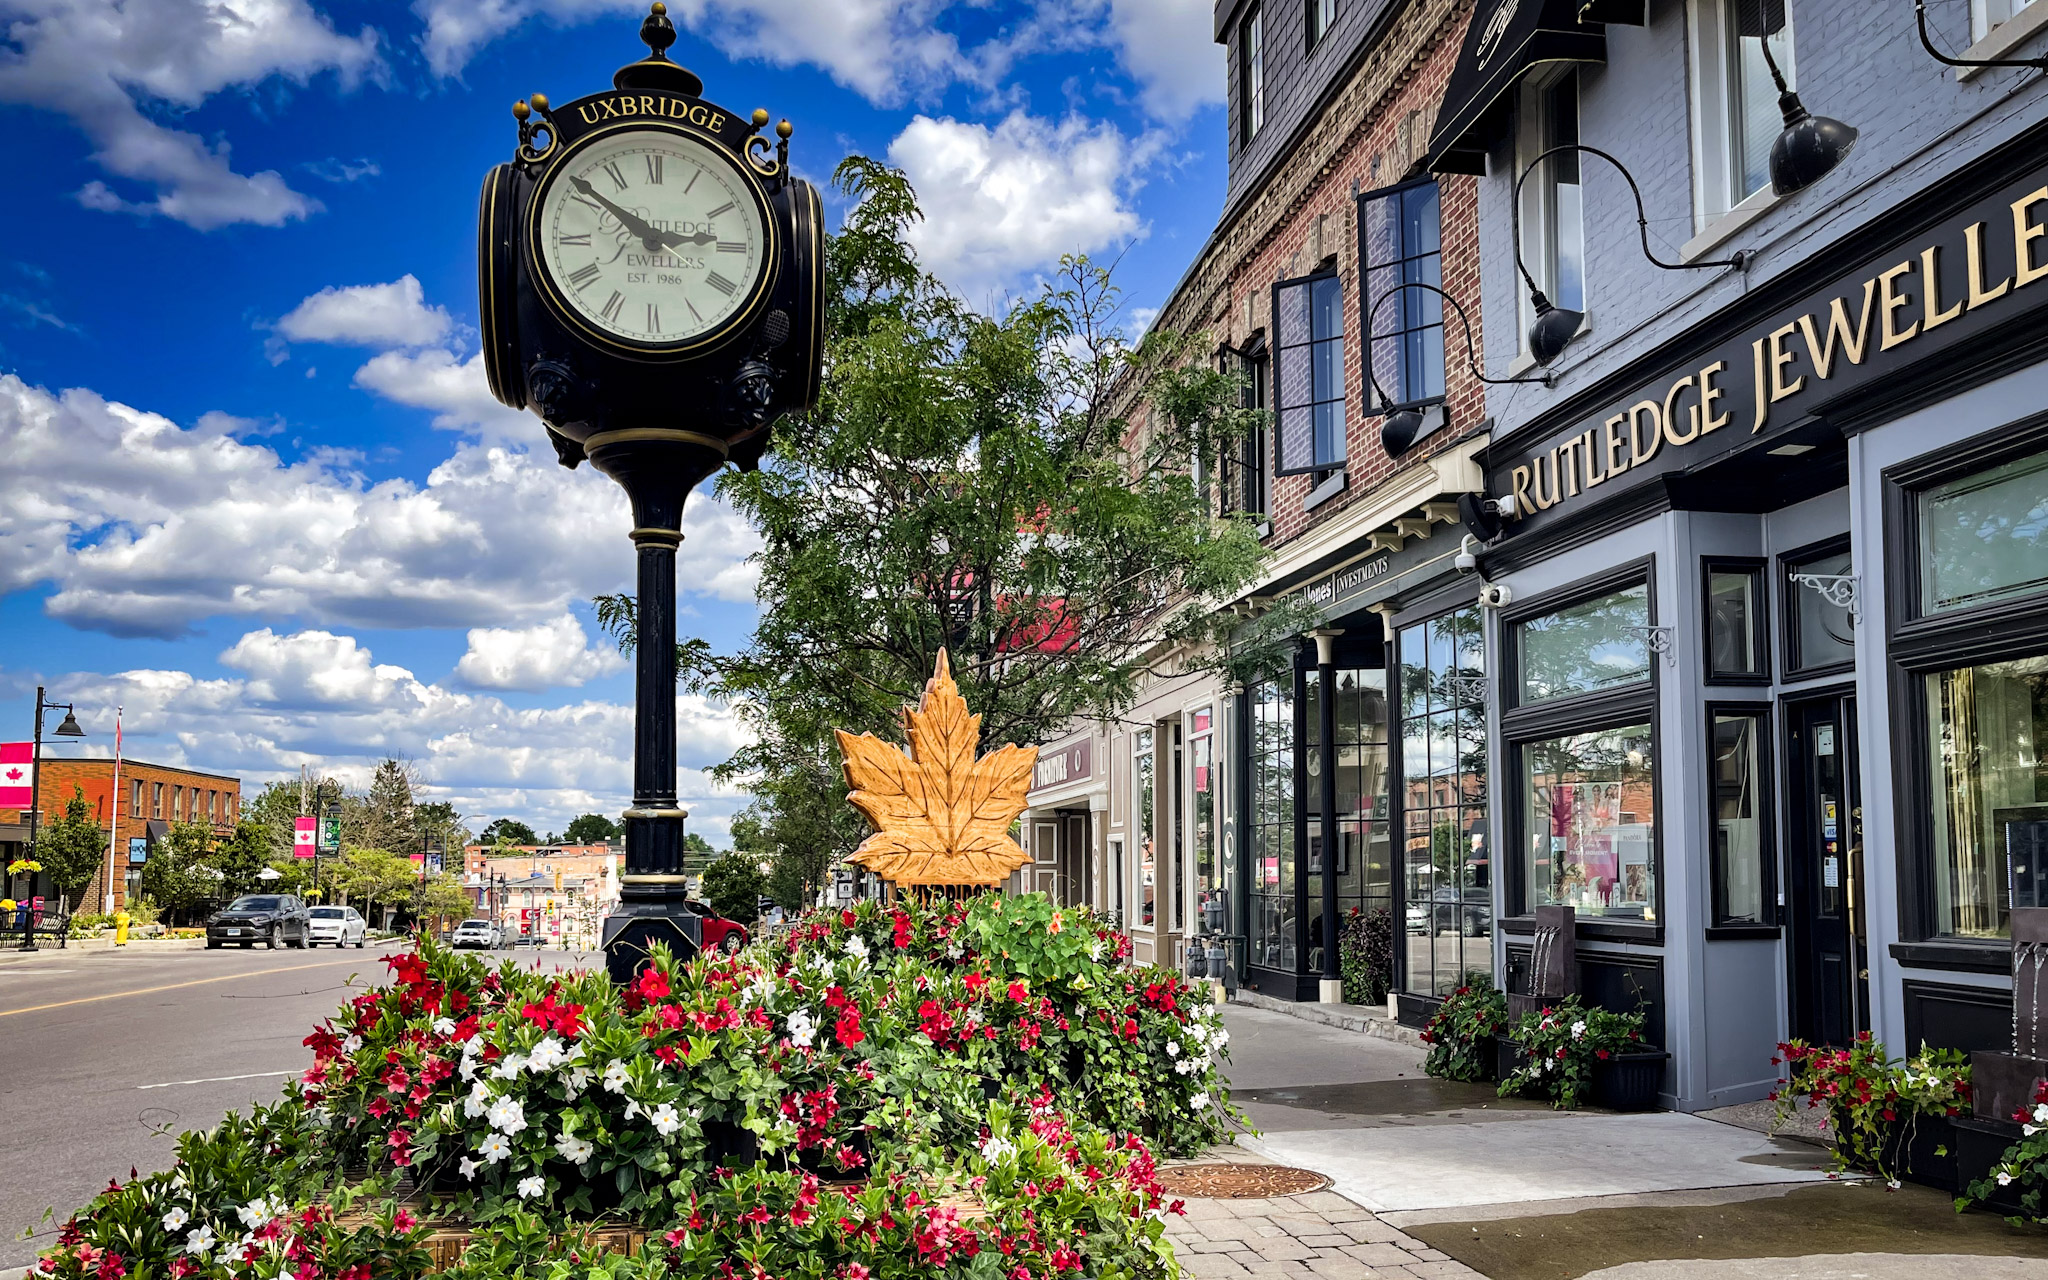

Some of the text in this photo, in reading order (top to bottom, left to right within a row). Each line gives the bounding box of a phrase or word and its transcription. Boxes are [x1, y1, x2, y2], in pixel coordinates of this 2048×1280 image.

[577, 96, 726, 134] UXBRIDGE
[645, 155, 664, 185] XII
[627, 273, 682, 285] EST. 1986
[1511, 185, 2048, 521] RUTLEDGE JEWELLE
[1336, 556, 1388, 594] INVESTMENTS
